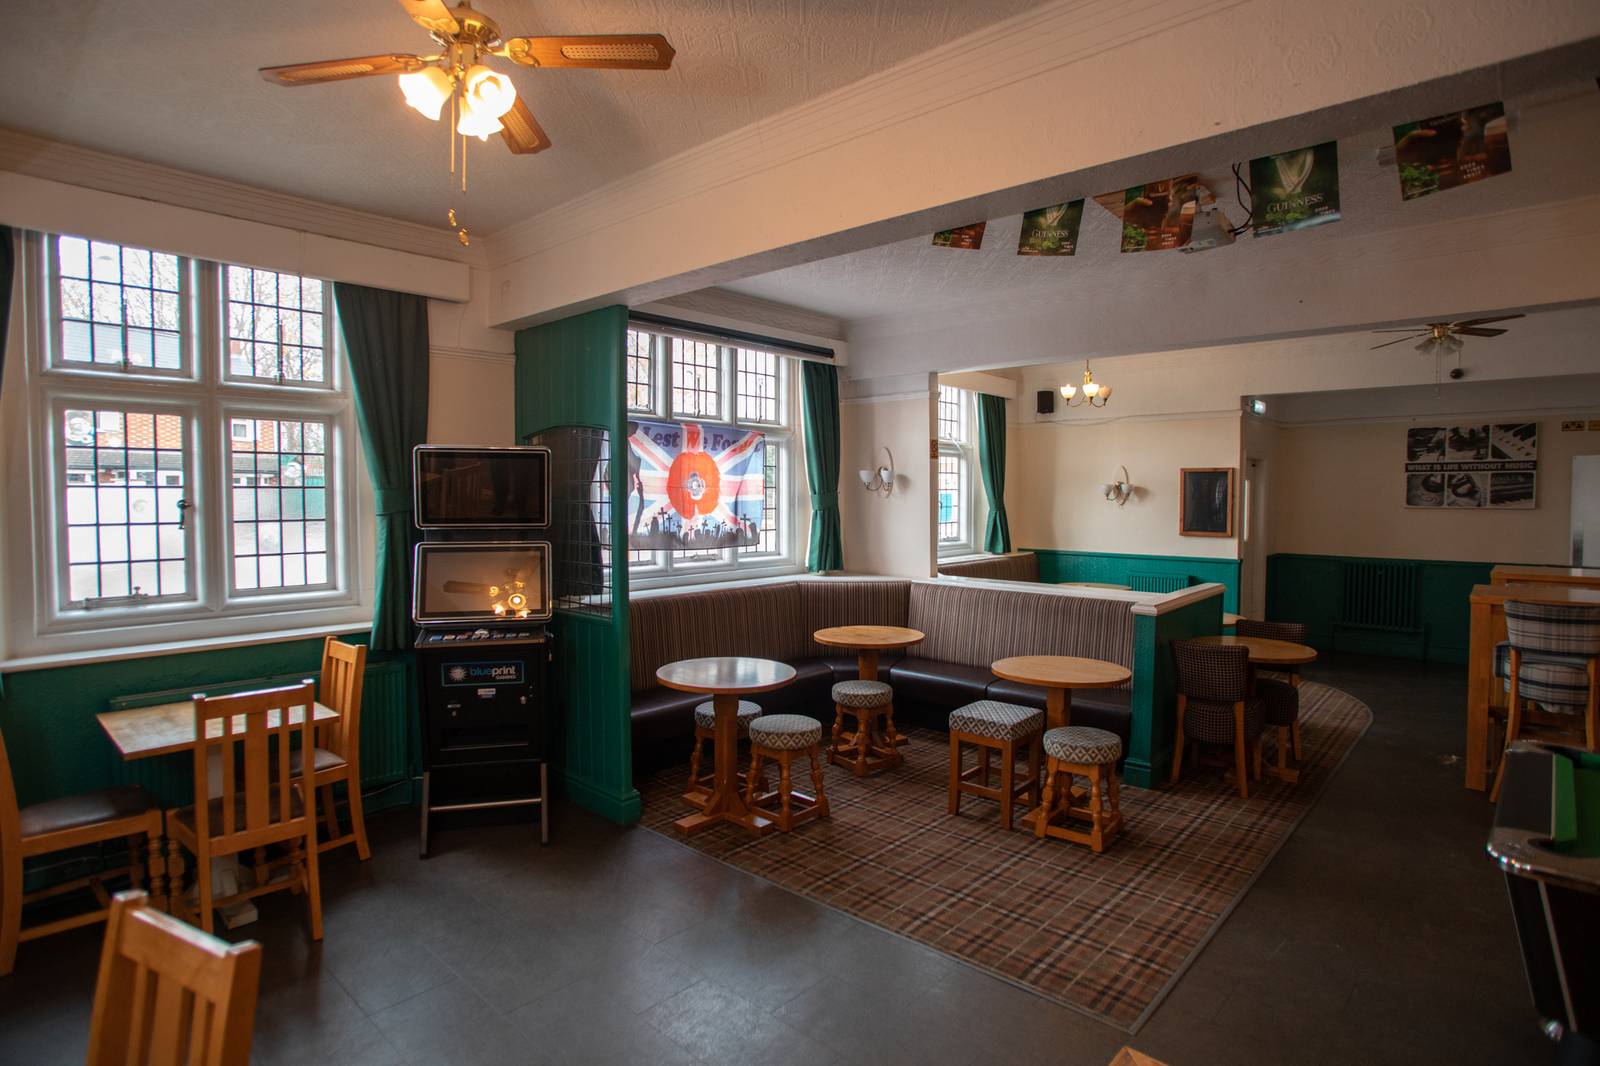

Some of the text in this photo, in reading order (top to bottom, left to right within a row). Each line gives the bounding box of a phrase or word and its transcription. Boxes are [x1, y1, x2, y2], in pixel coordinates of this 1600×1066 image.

[1266, 193, 1324, 213] GUINNESS
[1031, 228, 1069, 239] GUINNESS
[643, 426, 680, 448] Lest
[1407, 463, 1431, 471] WHAT
[1433, 463, 1442, 471] IS
[1461, 462, 1502, 470] WITHOUT
[470, 665, 517, 677] blueprint
